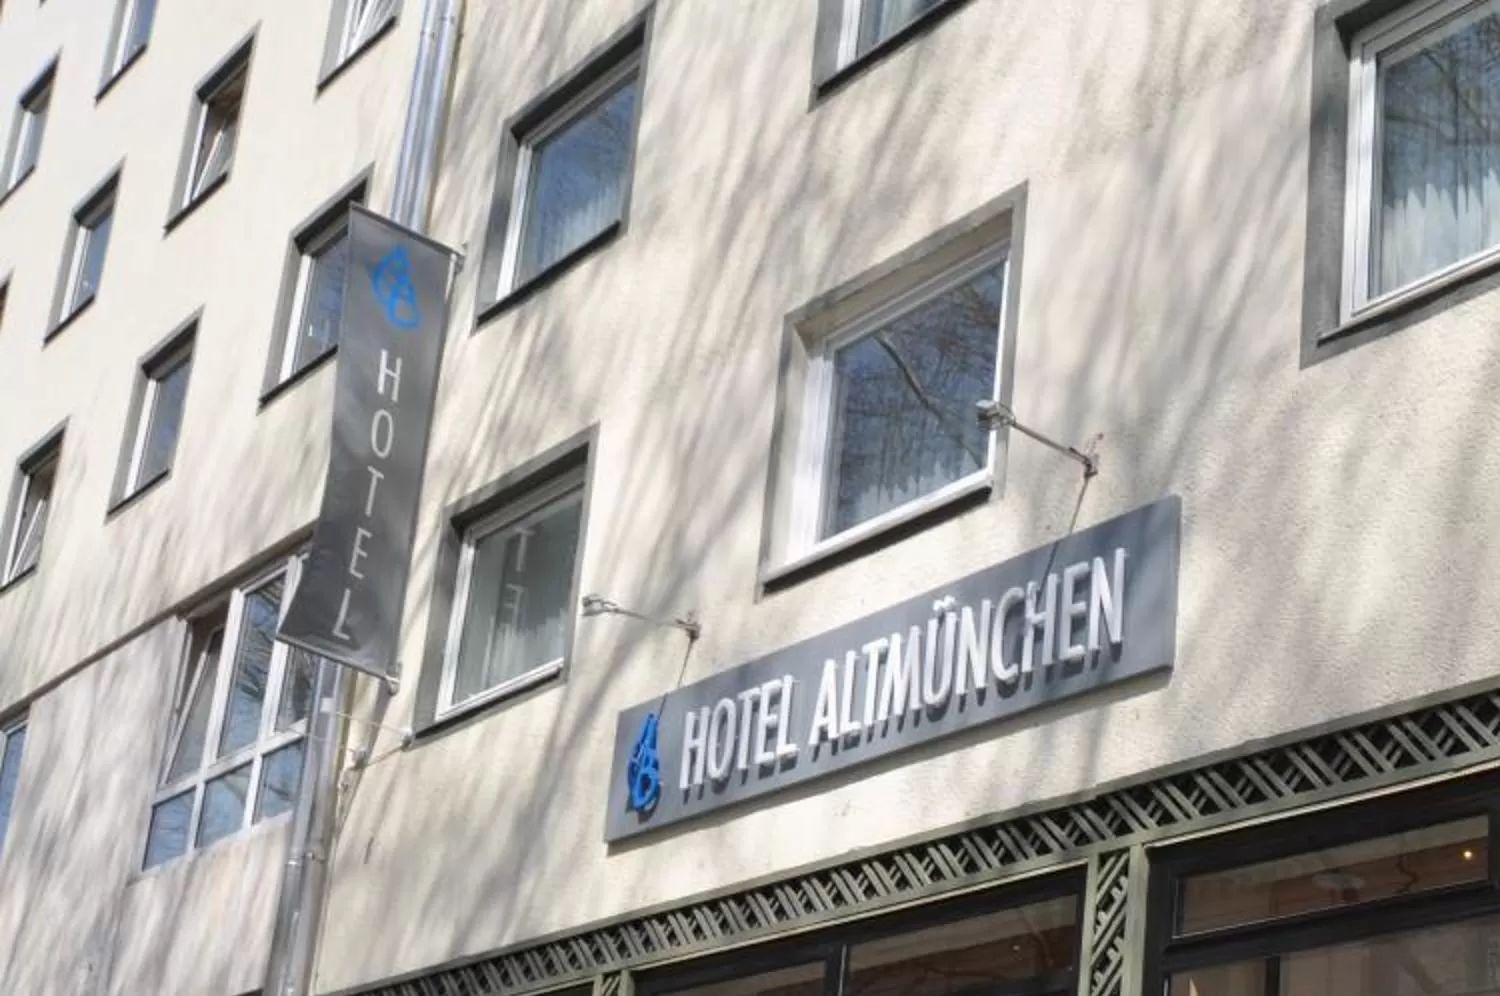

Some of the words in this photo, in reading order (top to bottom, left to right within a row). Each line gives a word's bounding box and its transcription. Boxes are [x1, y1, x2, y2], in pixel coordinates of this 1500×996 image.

[331, 348, 402, 641] HOTEL
[679, 674, 800, 790] HOTEL
[808, 547, 1129, 747] ALTMÜNCHEN
